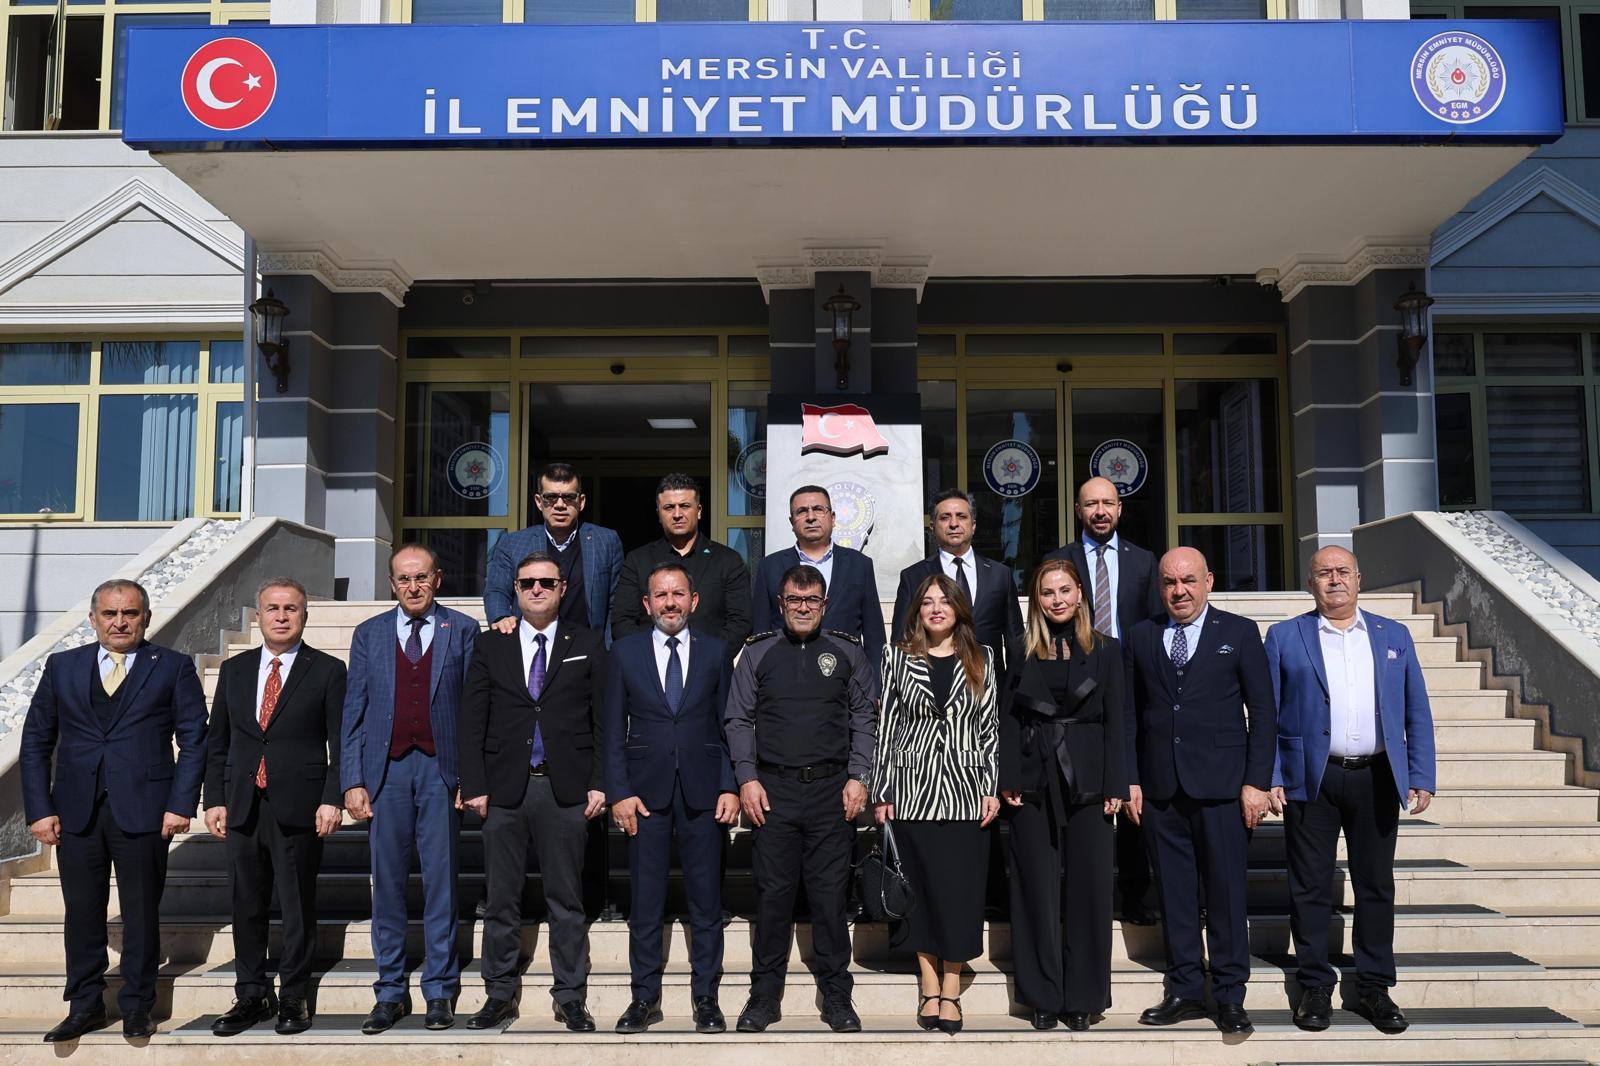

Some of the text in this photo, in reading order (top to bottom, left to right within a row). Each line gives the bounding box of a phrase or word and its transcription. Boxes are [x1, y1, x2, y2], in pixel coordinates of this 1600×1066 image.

[801, 28, 880, 50] T.C.
[661, 51, 1021, 80] MERSİN VALİLİĞİ
[1416, 37, 1500, 79] MERSİN EMNİYET MÜDÜRLÜĞÜ
[424, 83, 1257, 134] İL EMNİYET MÜDÜRLÜĞÜ
